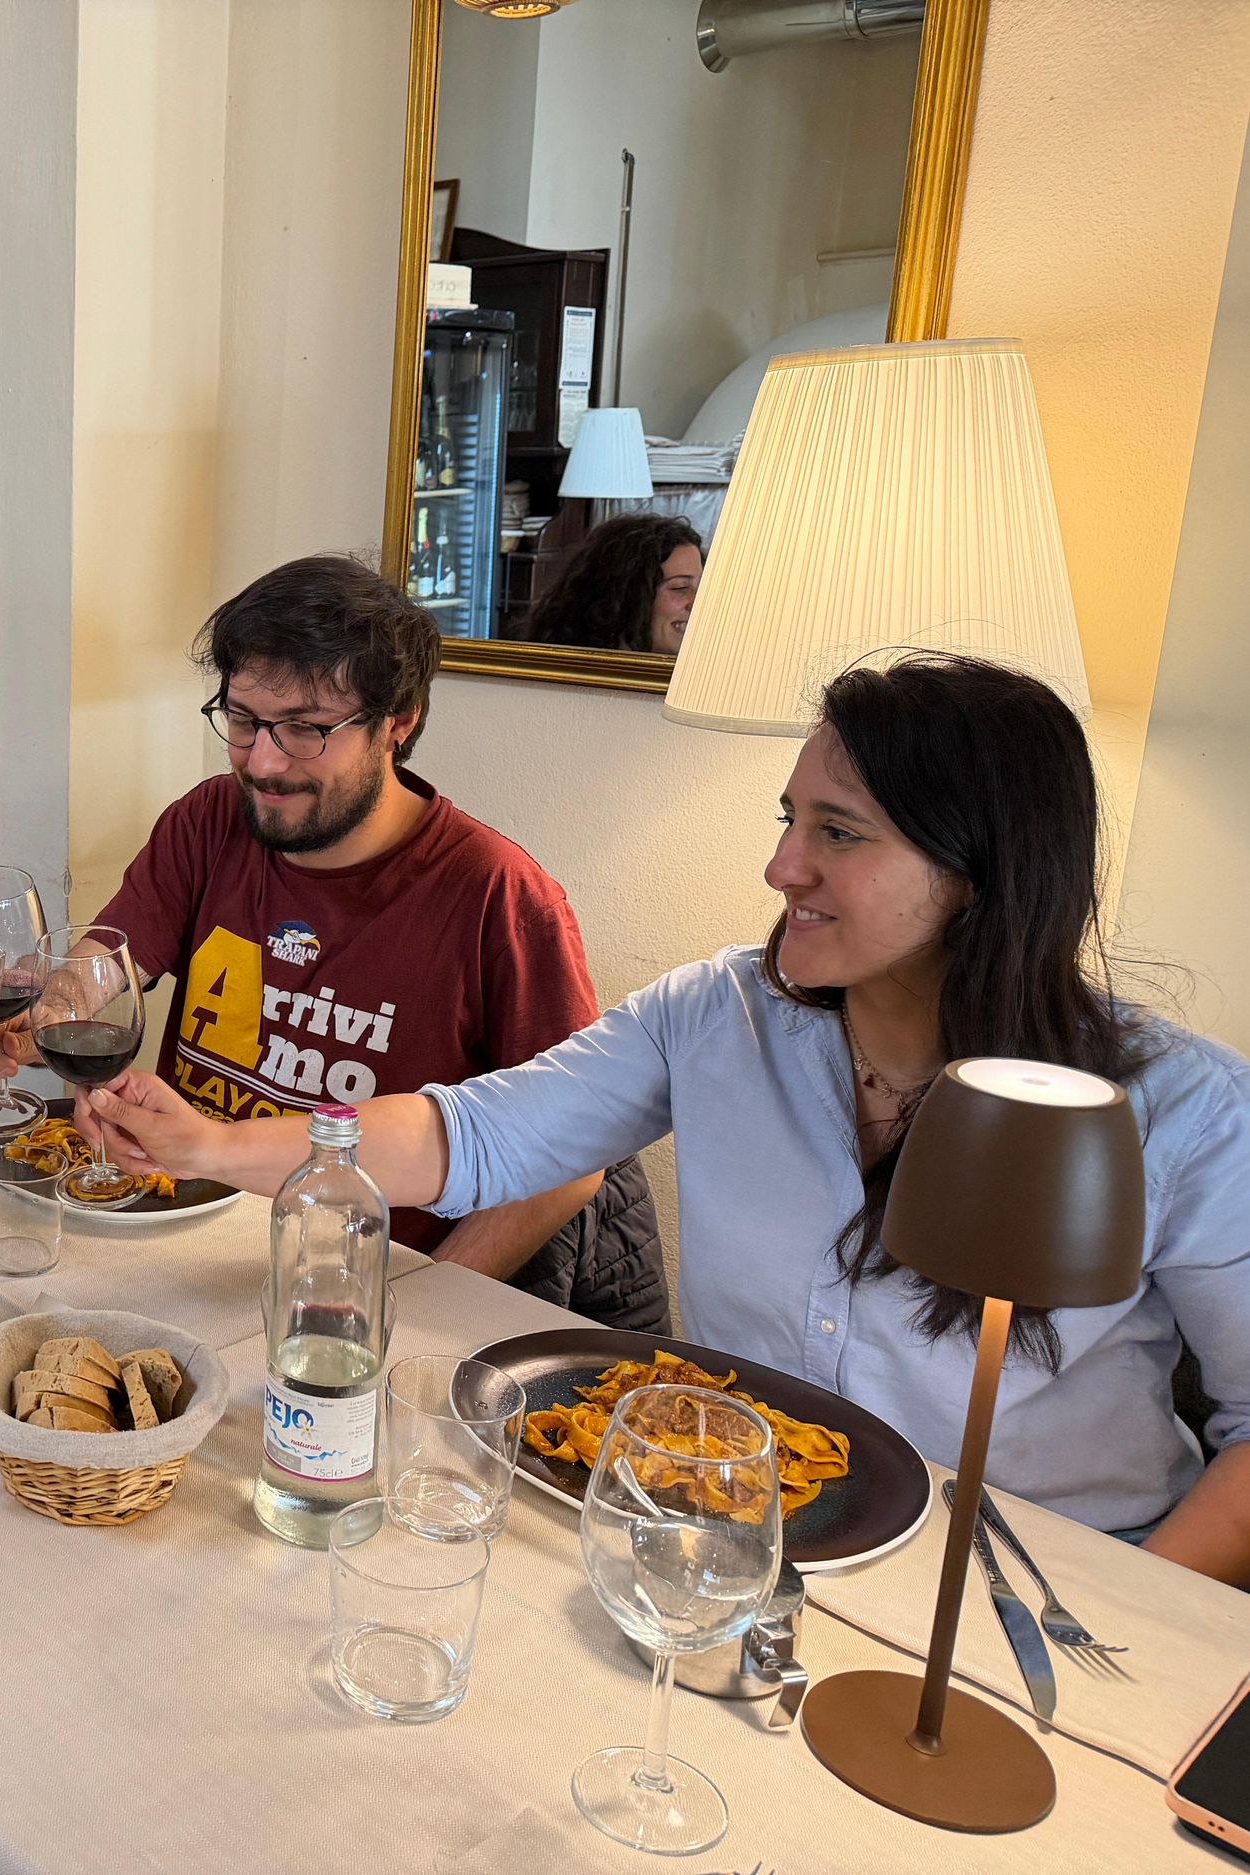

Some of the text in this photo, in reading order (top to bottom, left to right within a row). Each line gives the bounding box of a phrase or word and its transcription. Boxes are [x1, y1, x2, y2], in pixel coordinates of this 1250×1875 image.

[266, 935, 318, 961] TRAPANI
[271, 948, 305, 967] SHARK
[266, 1384, 314, 1429] PEJO
[291, 1439, 322, 1451] naturale
